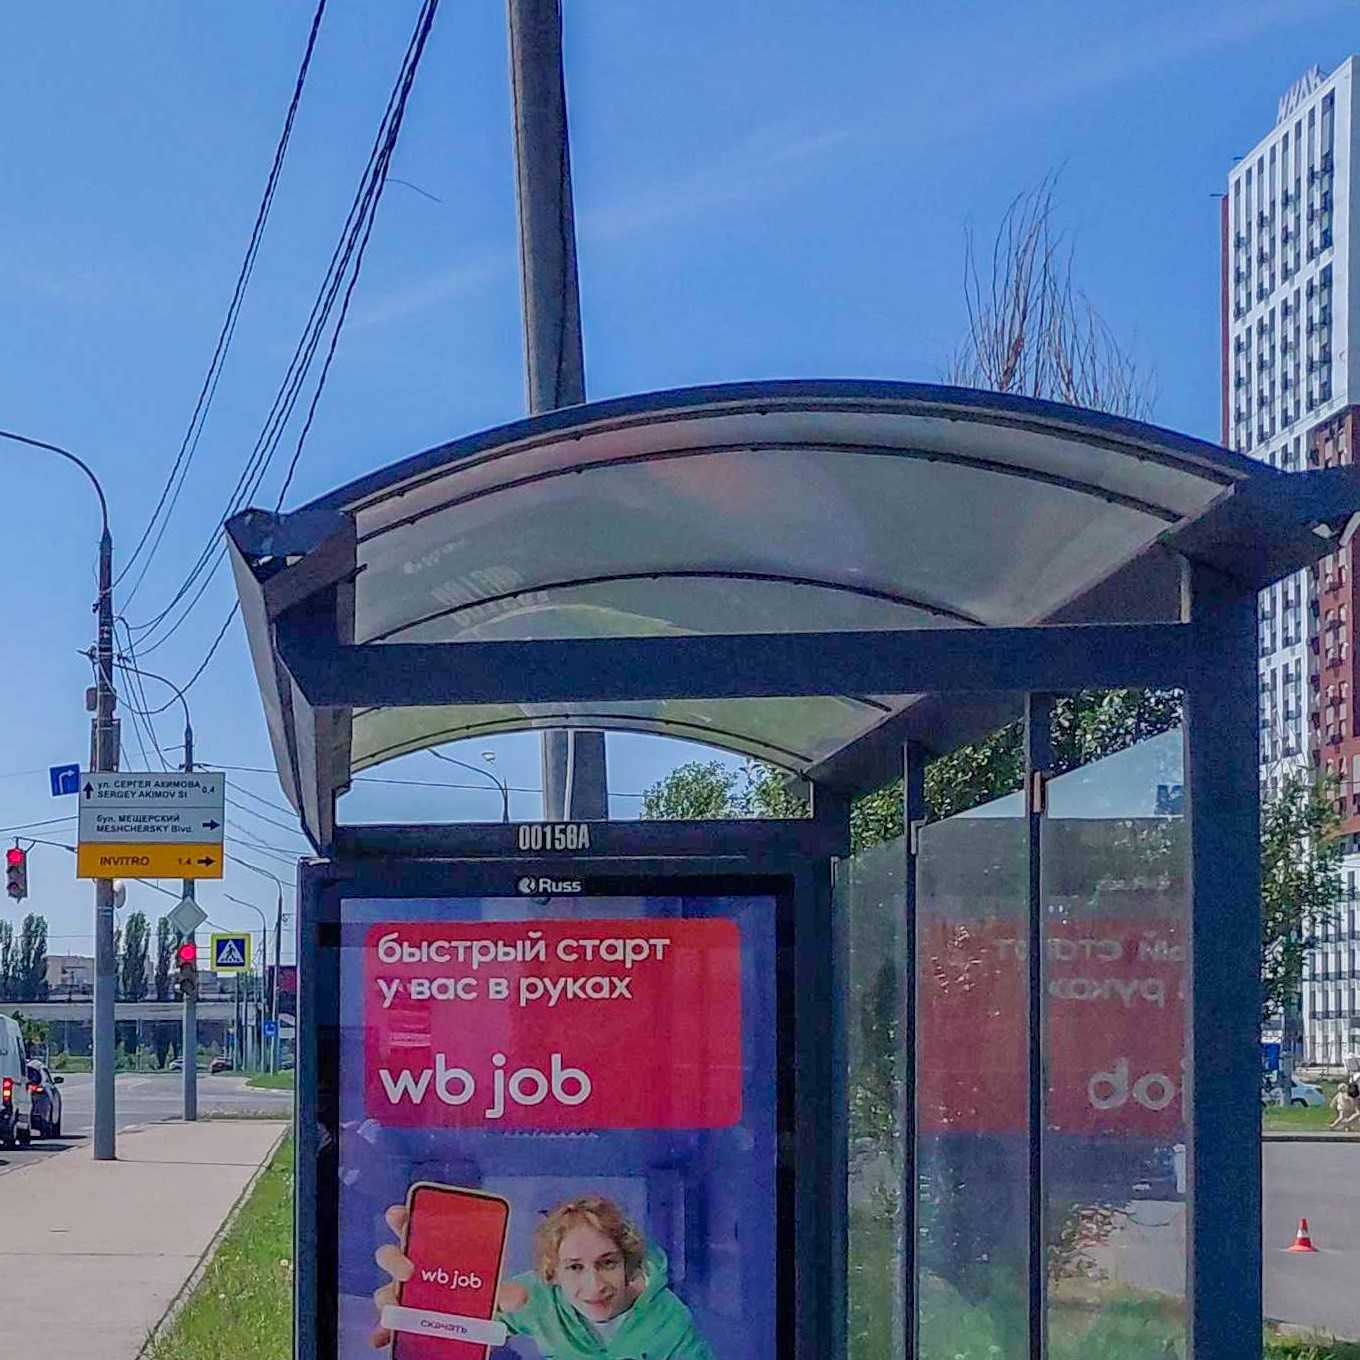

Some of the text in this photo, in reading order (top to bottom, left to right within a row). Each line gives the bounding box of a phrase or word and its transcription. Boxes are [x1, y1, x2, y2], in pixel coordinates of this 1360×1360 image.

[113, 780, 152, 789] СЕРГЕЯ
[154, 780, 201, 789] АКИМОВА
[97, 790, 137, 799] SERGEY
[138, 790, 176, 799] AKIMOV
[118, 813, 180, 823] МЕЩЕРСКИЙ
[96, 824, 169, 833] MESHCHERSKY
[518, 823, 591, 851] 00158A
[100, 856, 151, 866] INVITRO
[538, 878, 582, 893] Russ
[376, 931, 672, 970] быстрый старт
[375, 975, 634, 1009] у вас в руках
[378, 1052, 593, 1119] wb job
[420, 1267, 483, 1290] wb job
